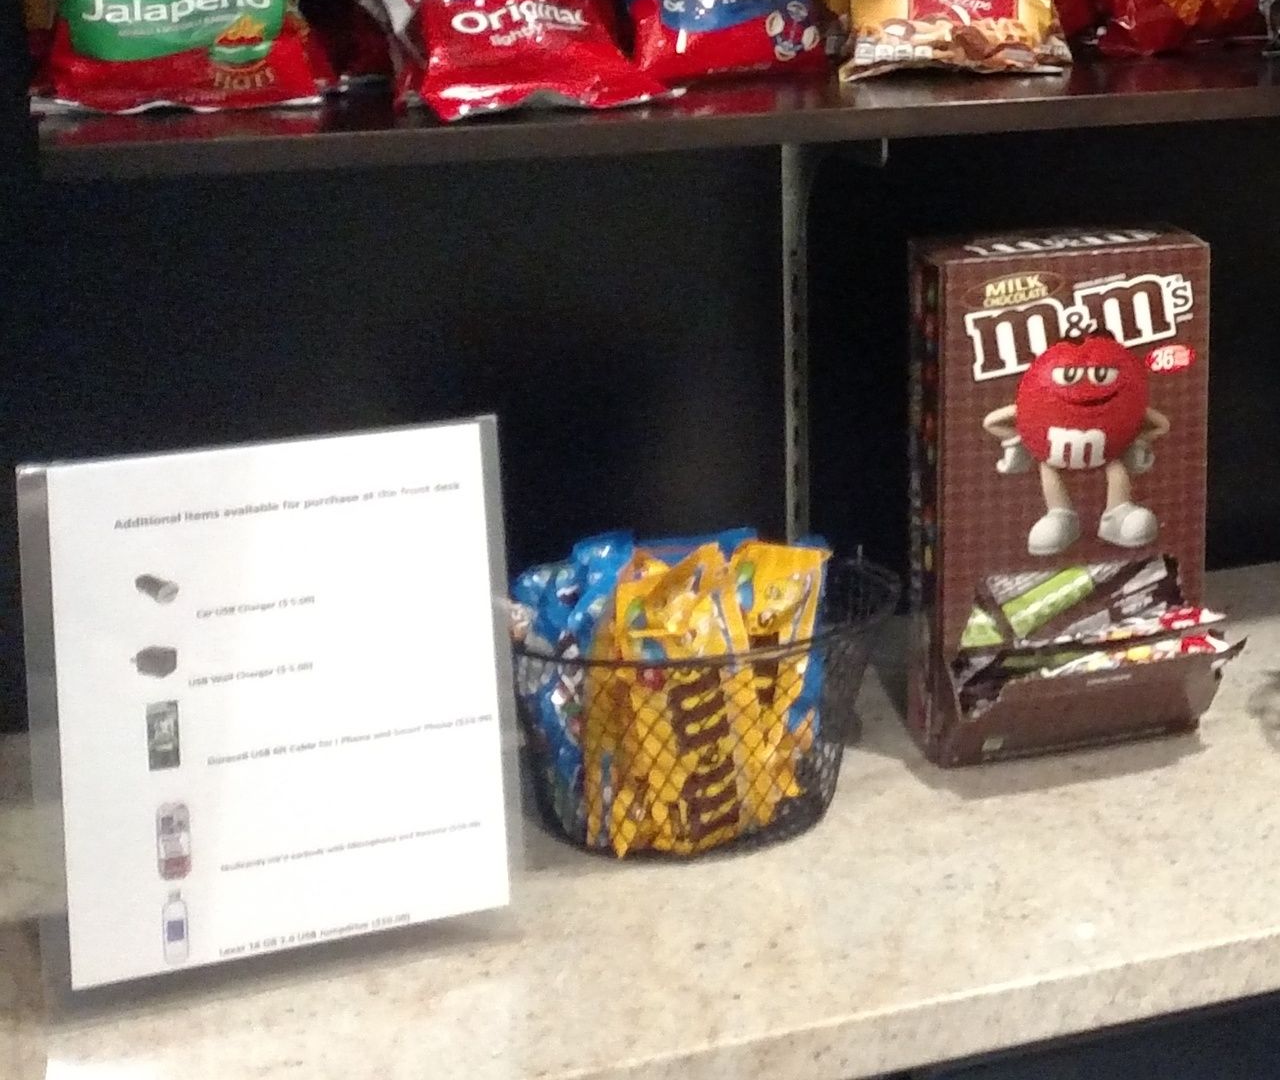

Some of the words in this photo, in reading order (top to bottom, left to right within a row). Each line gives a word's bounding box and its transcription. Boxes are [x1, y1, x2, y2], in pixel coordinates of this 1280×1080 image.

[982, 289, 1050, 309] CHOCOLATE
[984, 274, 1046, 299] MILK
[1149, 347, 1176, 372] 36
[1046, 424, 1107, 471] m
[114, 513, 181, 530] Additional
[184, 509, 220, 522] items
[223, 501, 279, 518] available
[282, 498, 300, 510] for
[304, 493, 359, 510] purchase
[362, 491, 374, 501] at
[434, 481, 460, 492] desk
